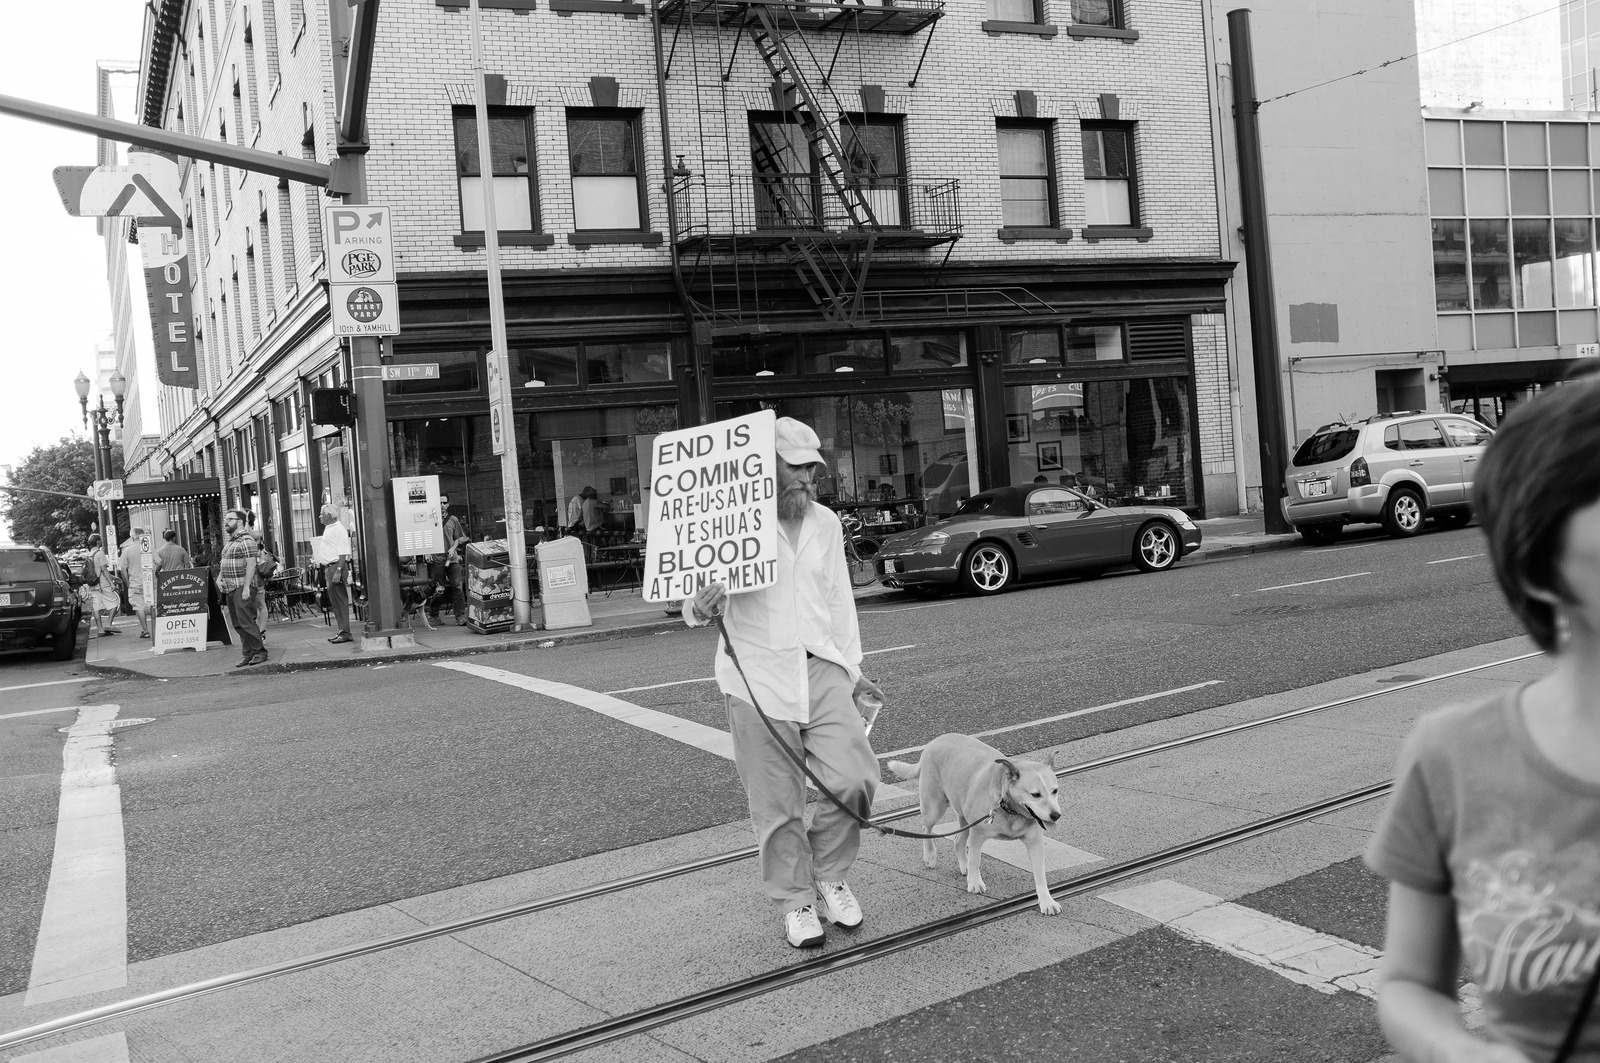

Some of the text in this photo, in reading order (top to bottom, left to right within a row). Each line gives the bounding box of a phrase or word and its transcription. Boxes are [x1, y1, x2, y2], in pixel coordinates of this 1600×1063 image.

[347, 252, 375, 266] PGE
[348, 261, 377, 276] PARK
[160, 233, 189, 372] HOTEL
[349, 303, 381, 311] SMART
[339, 324, 393, 333] 10th & YAMHILL
[389, 366, 434, 378] SW 11TH AV
[657, 423, 751, 466] END IS
[653, 452, 764, 498] COMING
[674, 506, 762, 546] YESHUA'S
[658, 536, 761, 575] BLOOD
[160, 575, 180, 590] KENNY
[186, 574, 205, 587] ZUKE'S
[649, 559, 777, 600] AT-ONE-MENT
[166, 619, 196, 630] OPEN
